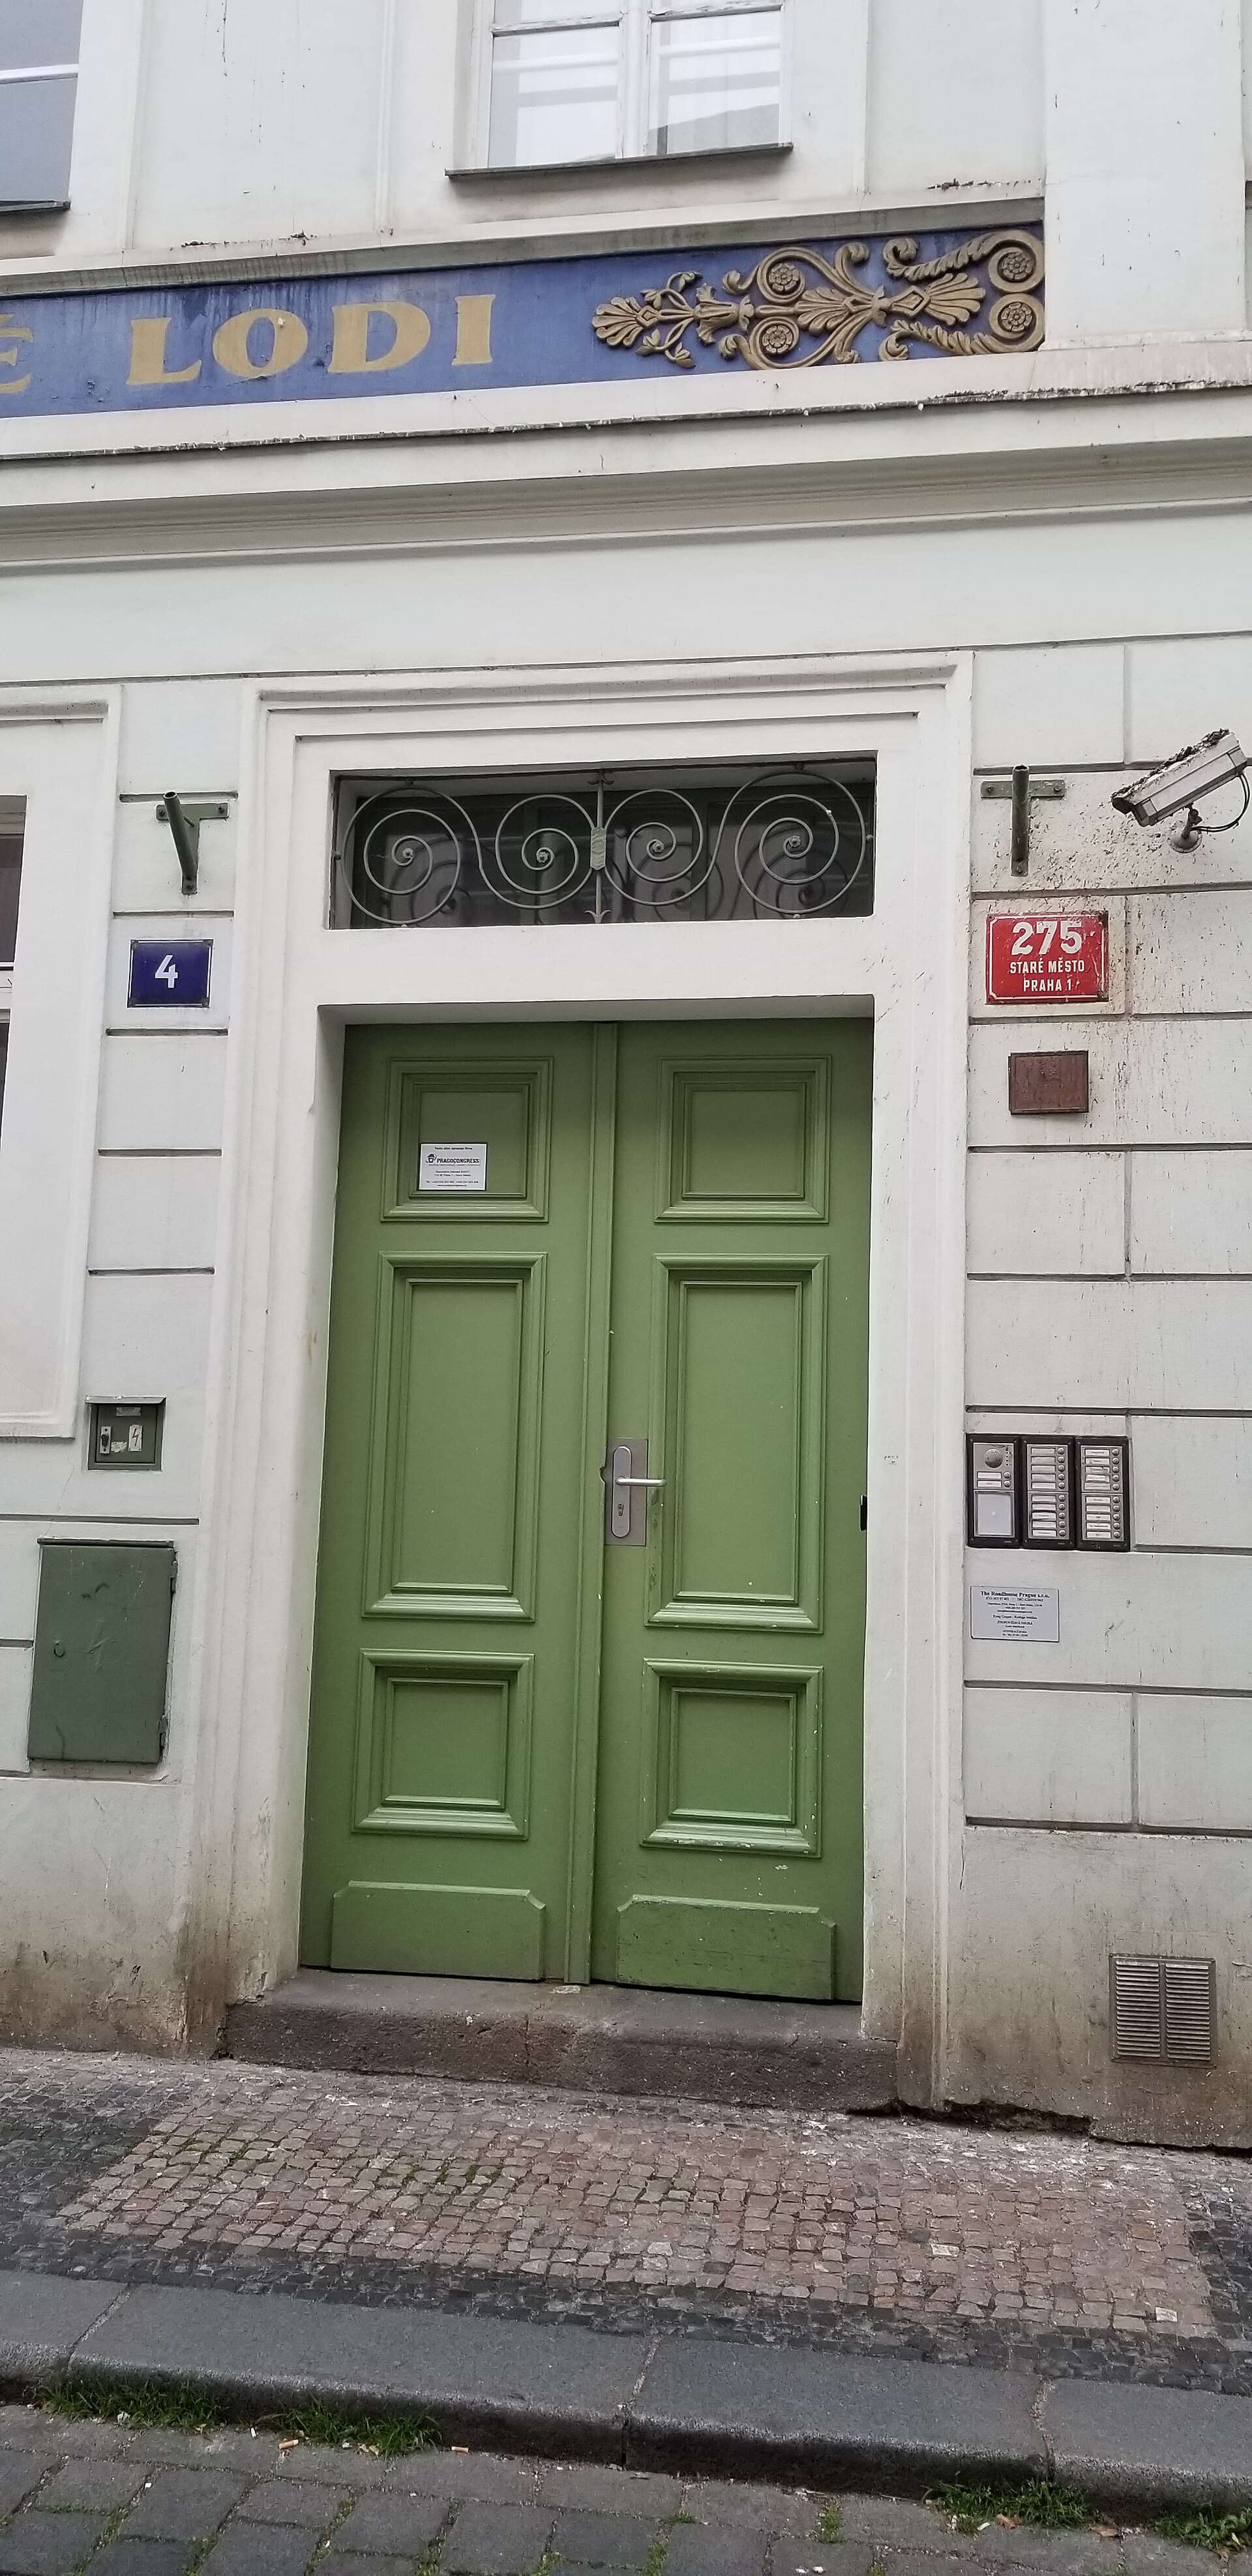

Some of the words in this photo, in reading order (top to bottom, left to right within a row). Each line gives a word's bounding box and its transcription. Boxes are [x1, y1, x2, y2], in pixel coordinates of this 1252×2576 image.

[126, 293, 496, 386] LODI
[1011, 920, 1082, 956] 275
[155, 954, 179, 989] 4
[1009, 957, 1044, 974] STARÉ
[1048, 957, 1085, 973] MĚSTO
[1023, 979, 1062, 992] PRAHA
[1067, 979, 1071, 991] 1
